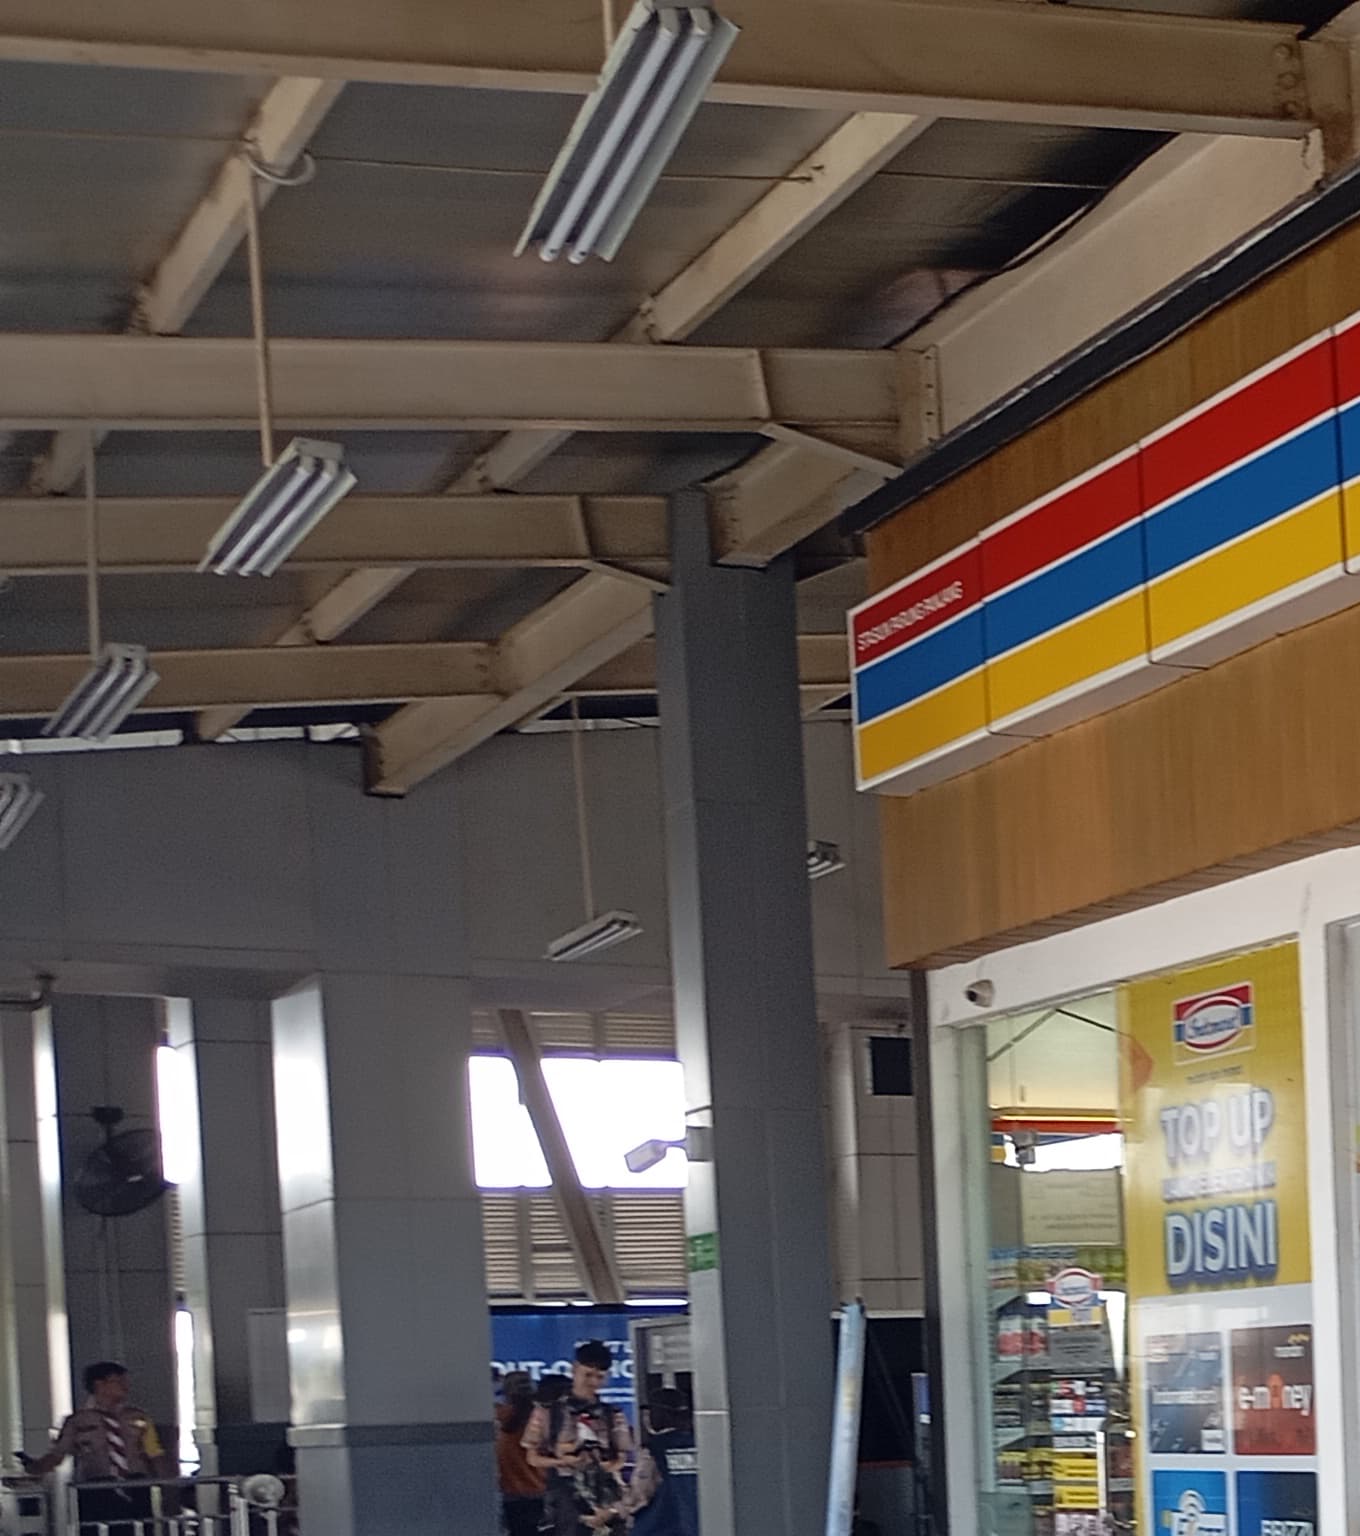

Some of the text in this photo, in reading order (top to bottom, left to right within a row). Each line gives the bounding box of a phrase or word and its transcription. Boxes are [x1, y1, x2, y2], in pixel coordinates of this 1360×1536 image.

[1160, 1088, 1274, 1162] TOP UP
[1165, 1199, 1279, 1285] DISINI
